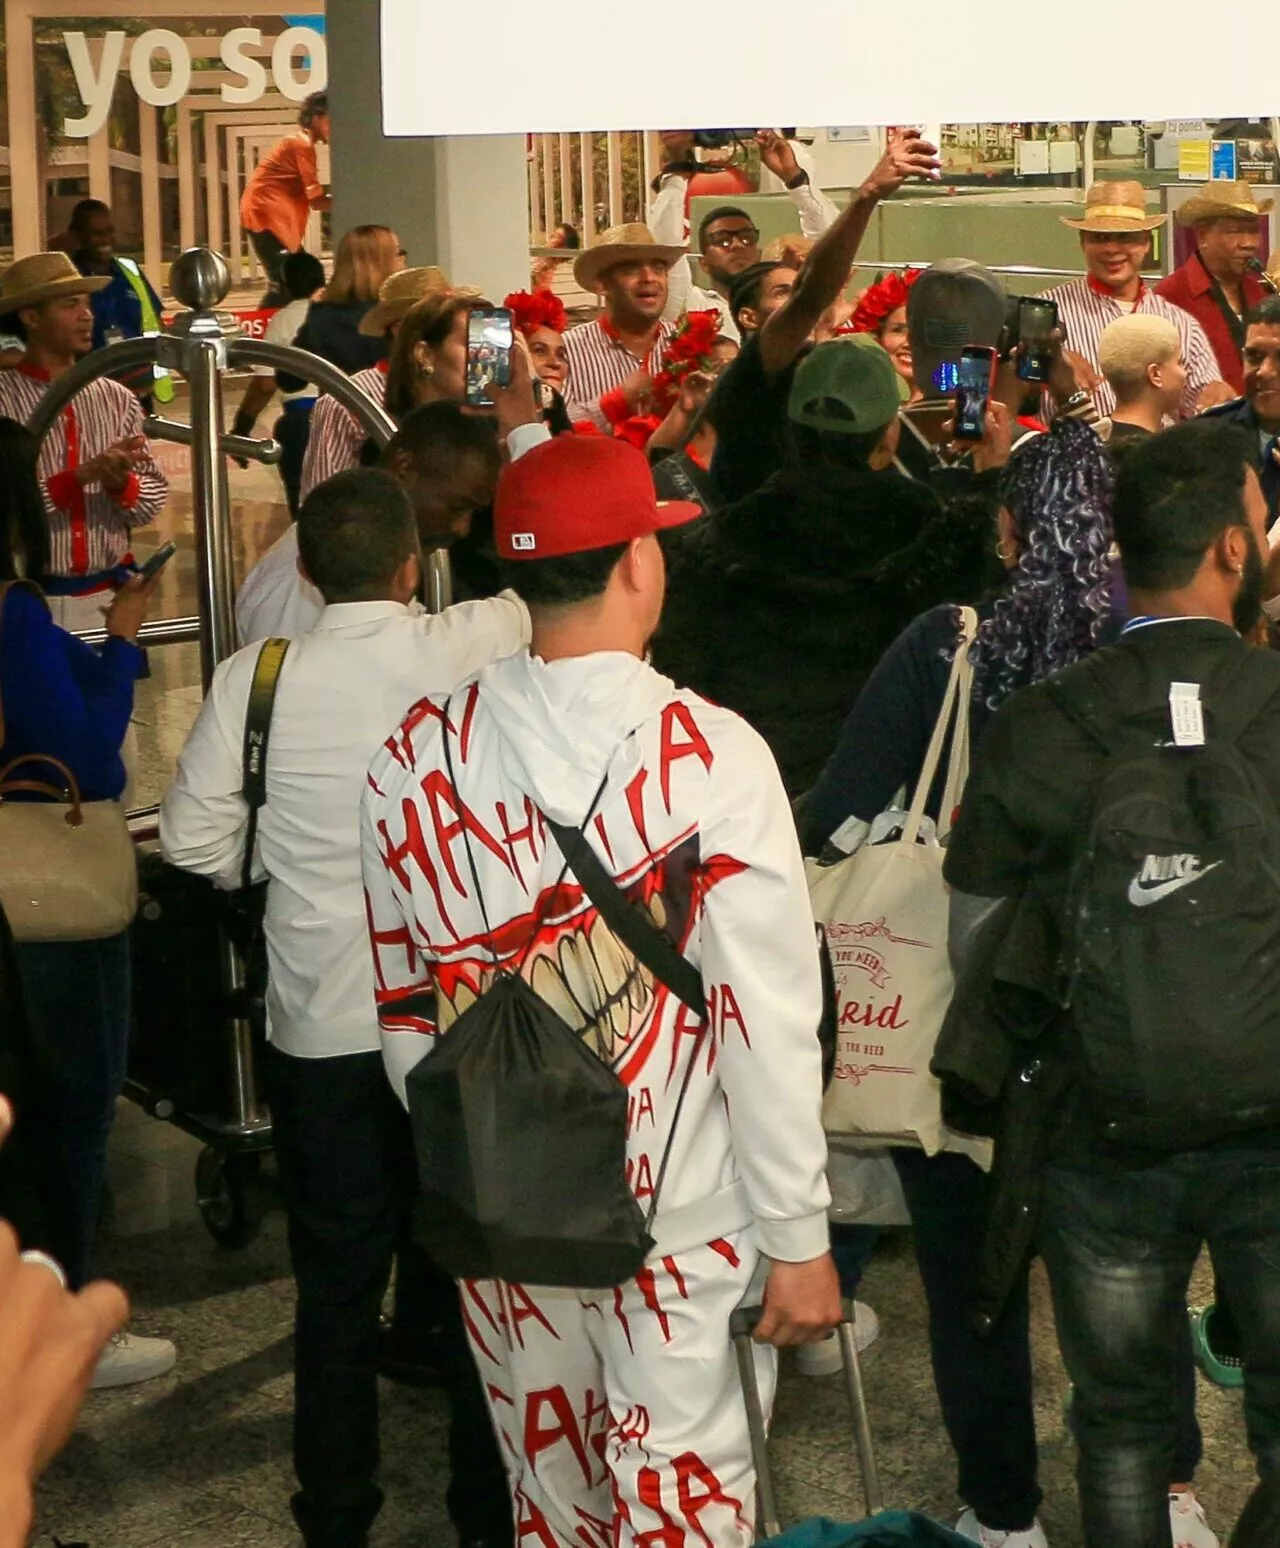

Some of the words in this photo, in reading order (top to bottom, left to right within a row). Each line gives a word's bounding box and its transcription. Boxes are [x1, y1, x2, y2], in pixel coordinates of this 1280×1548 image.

[63, 28, 193, 137] yo
[221, 26, 327, 104] so
[1140, 853, 1201, 882] NIKE
